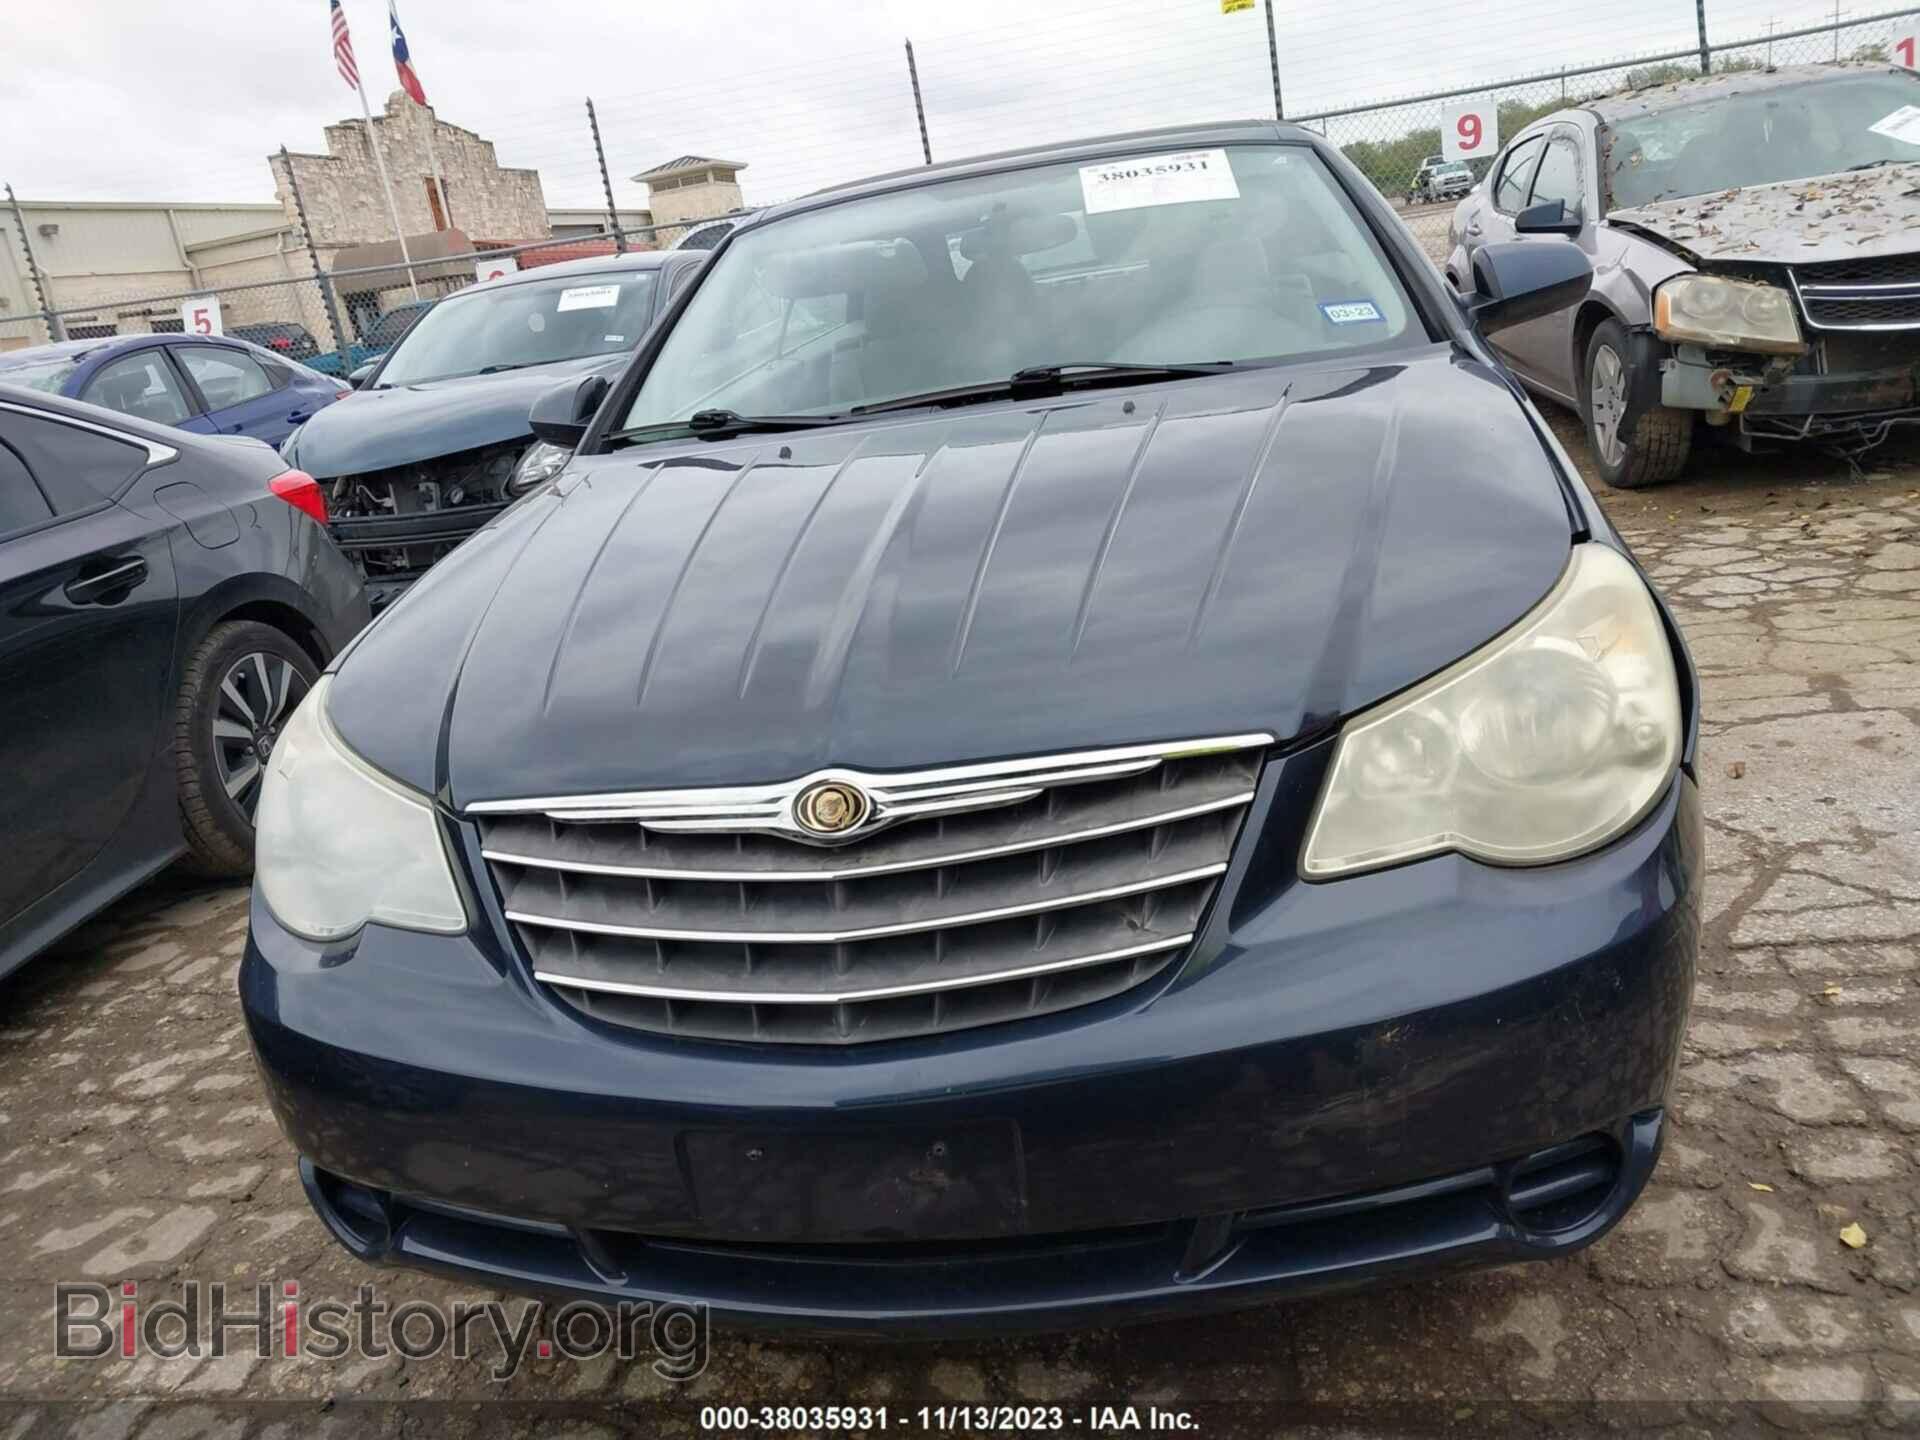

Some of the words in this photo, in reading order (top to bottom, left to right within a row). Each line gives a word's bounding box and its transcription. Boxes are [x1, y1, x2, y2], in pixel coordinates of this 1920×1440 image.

[1457, 113, 1483, 151] 9
[1097, 159, 1209, 184] 38035931
[193, 308, 212, 336] 5
